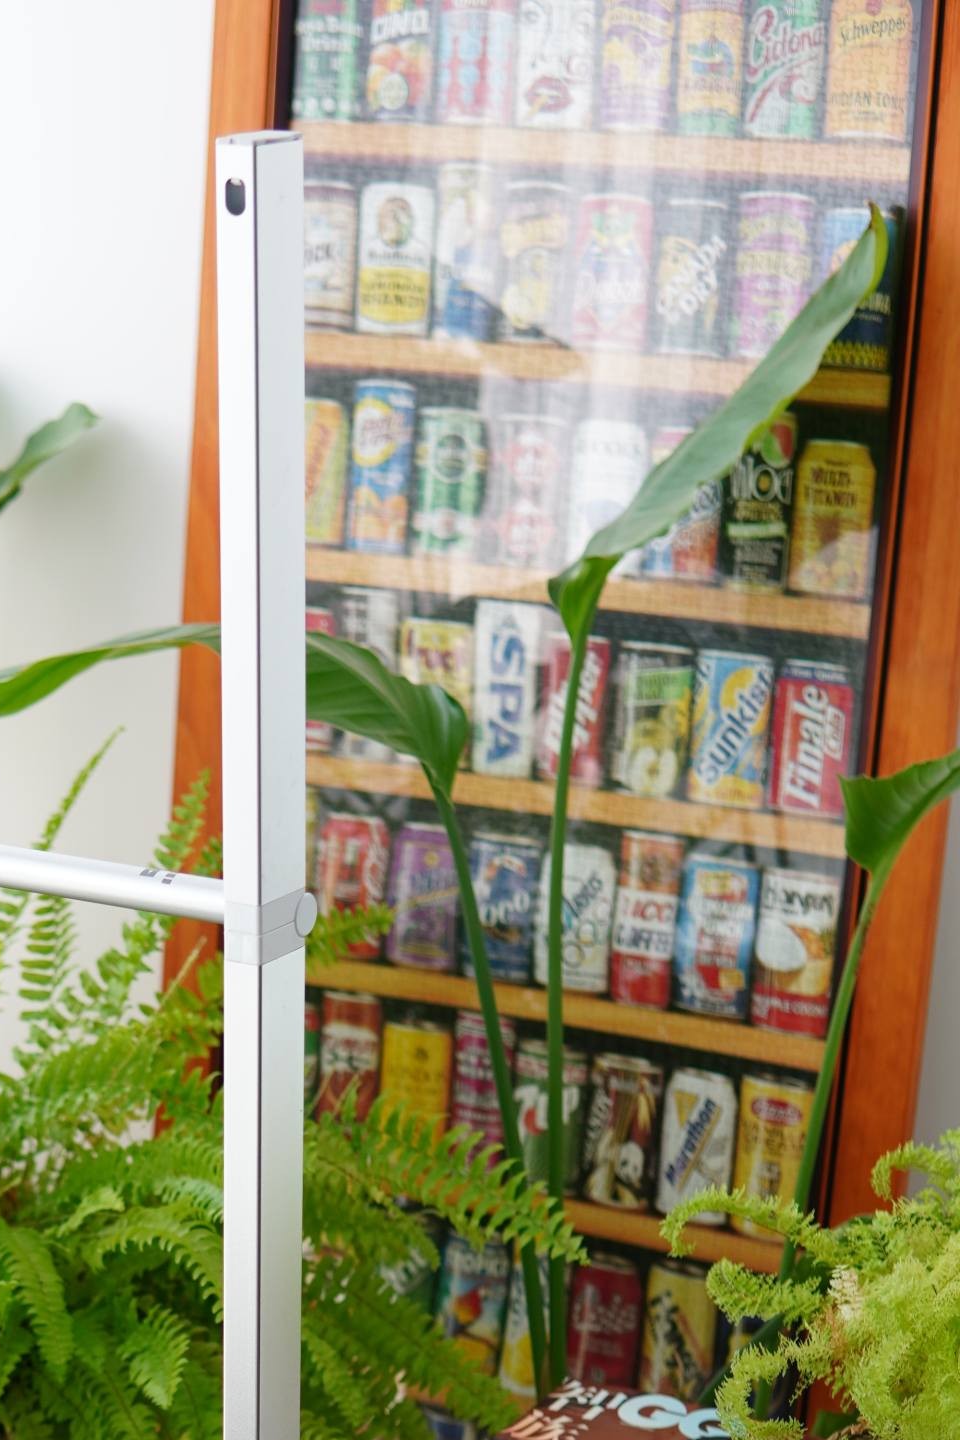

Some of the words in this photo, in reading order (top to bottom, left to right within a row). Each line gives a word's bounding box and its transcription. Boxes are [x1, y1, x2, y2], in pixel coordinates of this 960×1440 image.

[486, 632, 527, 764] SPA
[786, 684, 830, 809] Finale
[663, 1096, 719, 1187] Marathon
